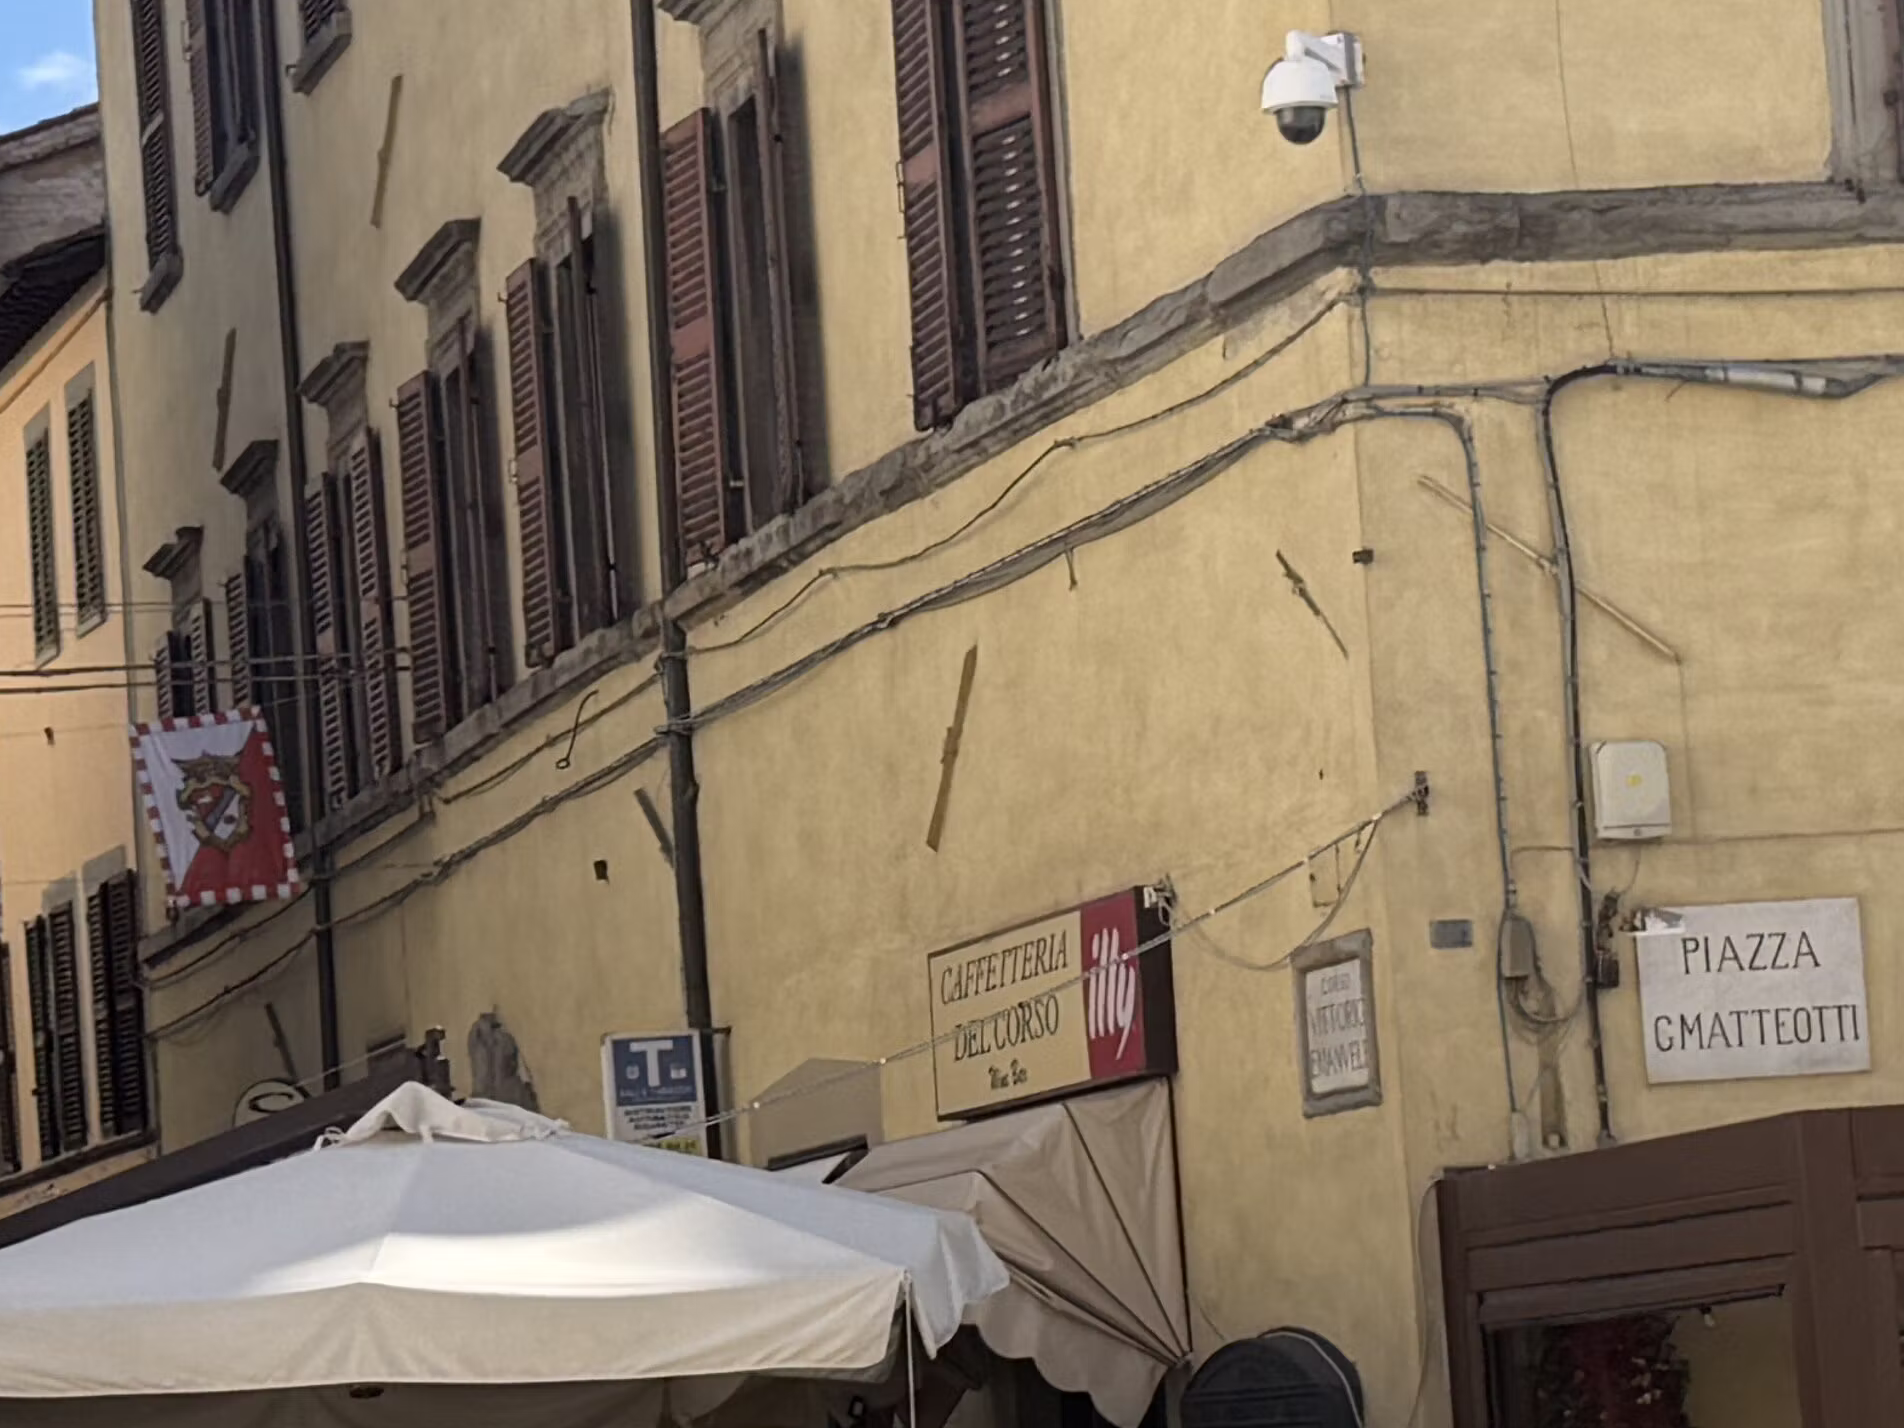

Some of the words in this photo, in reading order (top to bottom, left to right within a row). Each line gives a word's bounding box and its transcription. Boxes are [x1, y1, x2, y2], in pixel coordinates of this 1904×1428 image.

[941, 929, 1068, 1004] CAFFETTERIA
[1682, 931, 1820, 975] PIAZZA
[1089, 928, 1135, 1060] illy
[954, 1020, 992, 1062] DEL
[994, 994, 1059, 1051] CORSO
[629, 1040, 673, 1087] T
[989, 1064, 1009, 1090] Wine
[1010, 1059, 1028, 1085] Bar
